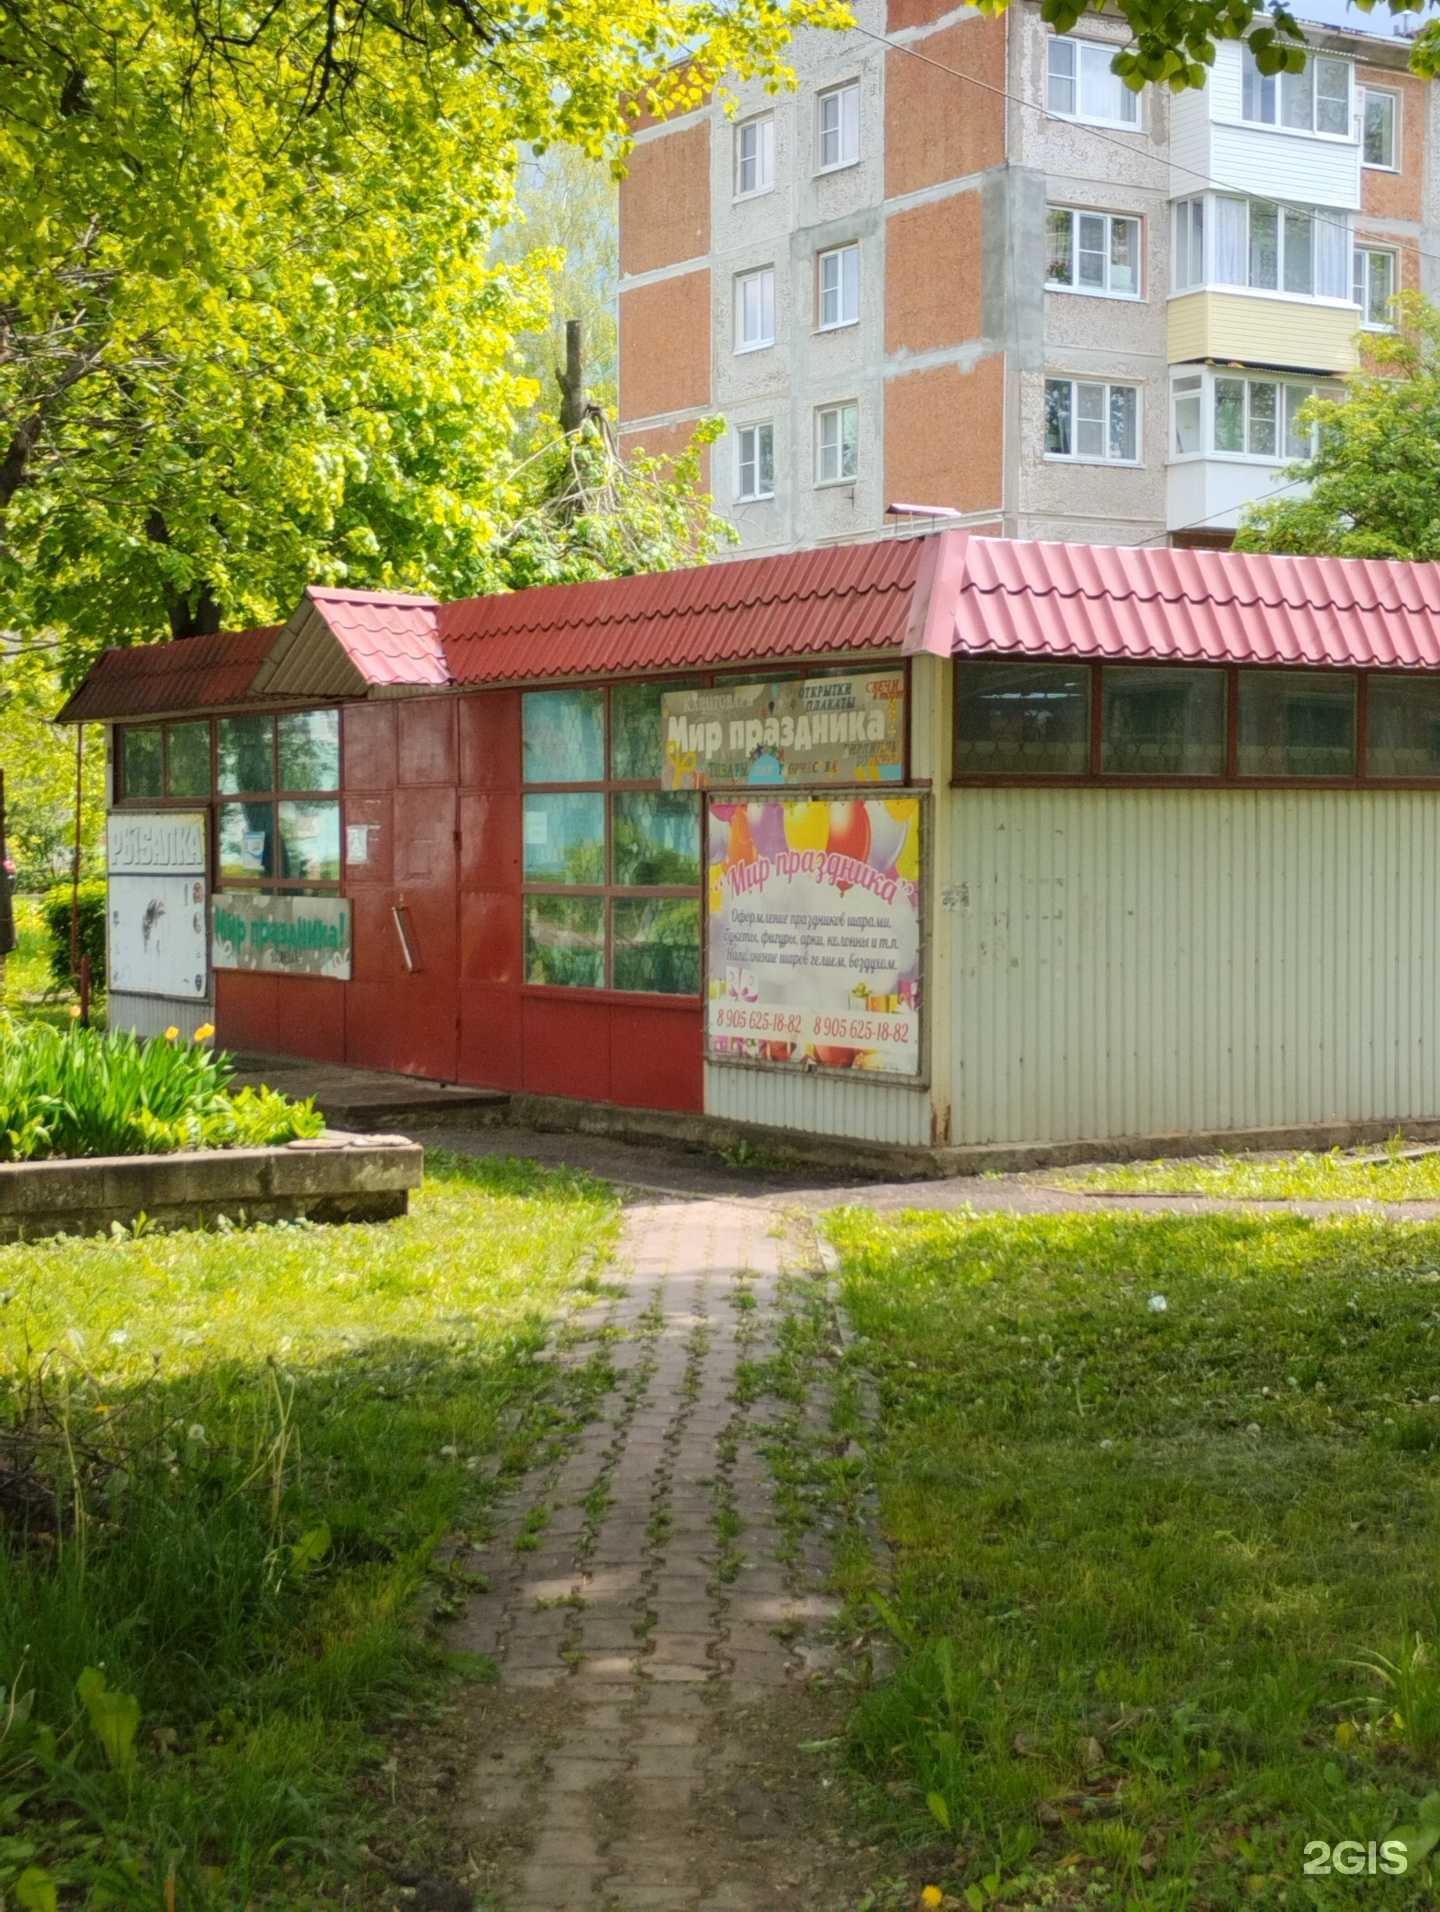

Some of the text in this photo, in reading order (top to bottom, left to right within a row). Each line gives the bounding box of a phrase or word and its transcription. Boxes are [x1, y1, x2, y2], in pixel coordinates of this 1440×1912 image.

[668, 716, 722, 759] Мир
[729, 709, 886, 757] праздника
[716, 1009, 801, 1033] 8 905 625-18-82
[813, 1016, 909, 1043] 8 905 625-18-82
